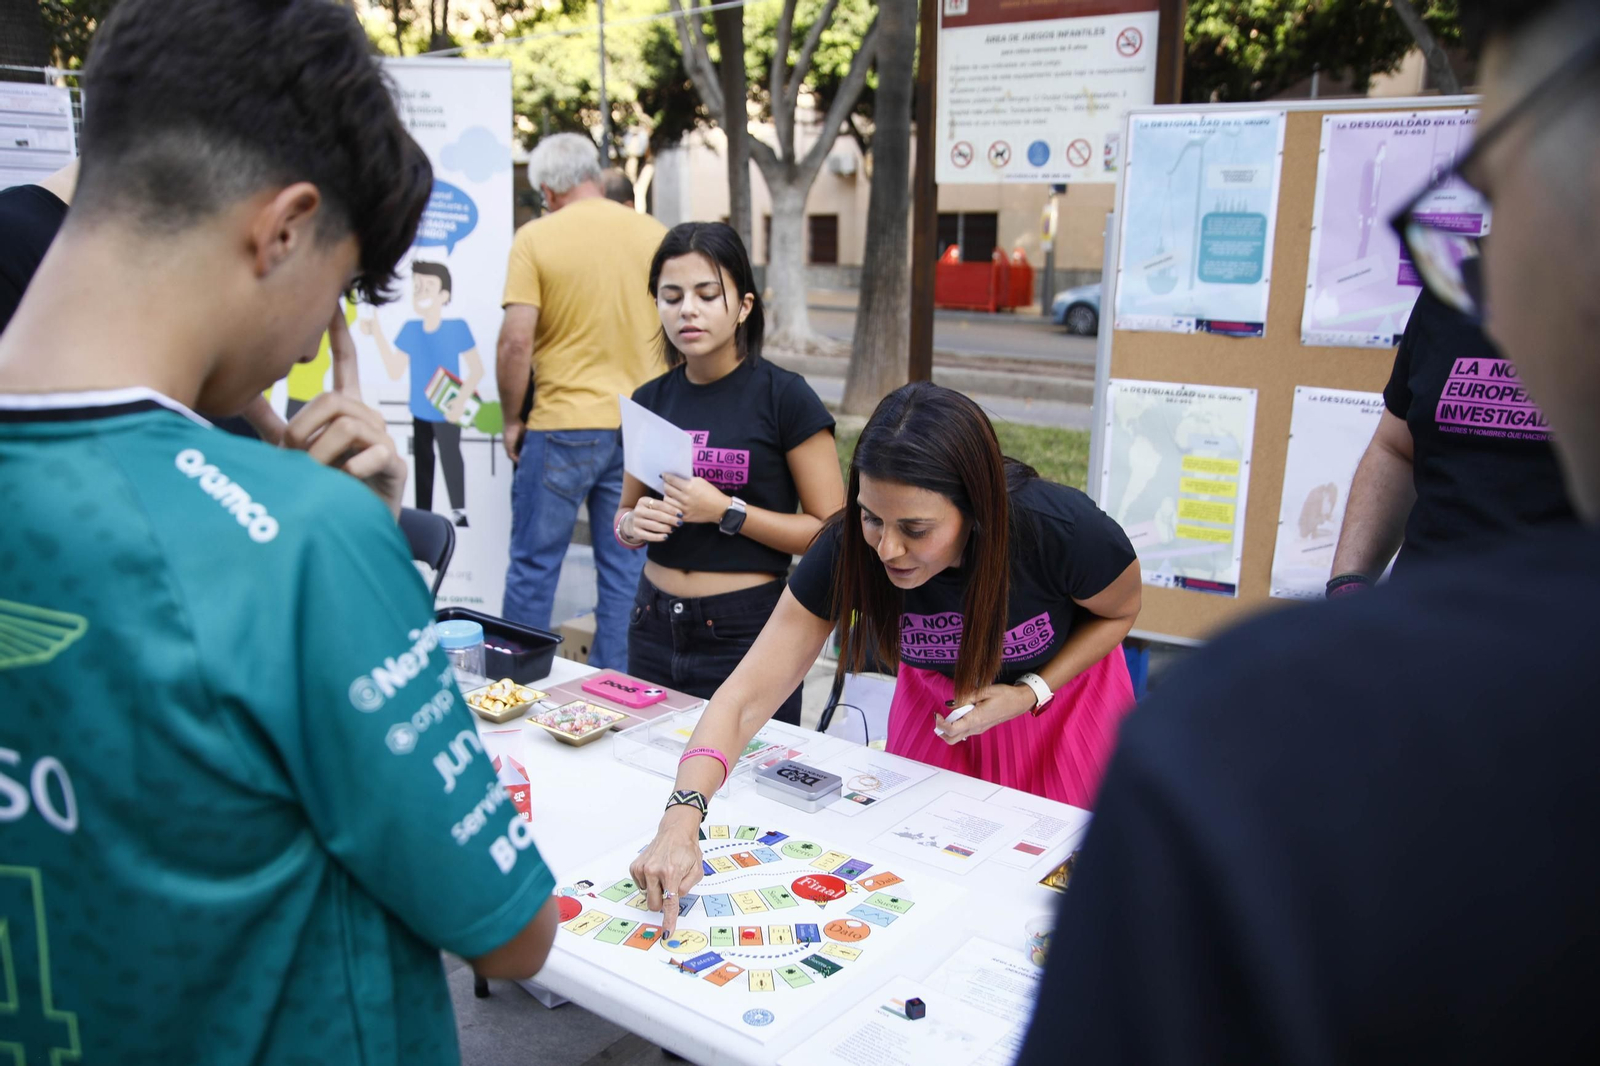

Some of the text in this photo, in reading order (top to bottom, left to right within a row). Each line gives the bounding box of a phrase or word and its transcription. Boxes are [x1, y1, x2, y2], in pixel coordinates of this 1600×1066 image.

[1350, 118, 1431, 130] DESIGUALDAD
[1434, 119, 1445, 127] EN
[1459, 118, 1478, 126] GRU
[1455, 361, 1518, 379] LA NO
[1439, 404, 1550, 428] INVESTIGAD
[1438, 425, 1468, 435] MUJERES
[1473, 428, 1507, 438] HOMBRES
[1507, 431, 1522, 440] QUE
[1523, 432, 1547, 441] HACEN
[697, 450, 745, 465] DE L@S
[175, 448, 279, 543] aramco
[922, 614, 963, 630] NOC
[1011, 618, 1046, 641] L@S
[599, 680, 639, 693] good
[489, 815, 533, 875] BO
[785, 844, 814, 857] Suerte
[797, 876, 845, 898] Final
[876, 877, 898, 886] Dato
[875, 898, 903, 910] Suerte
[583, 912, 605, 923] I+D
[681, 931, 705, 943] I+D
[827, 924, 862, 940] Dato
